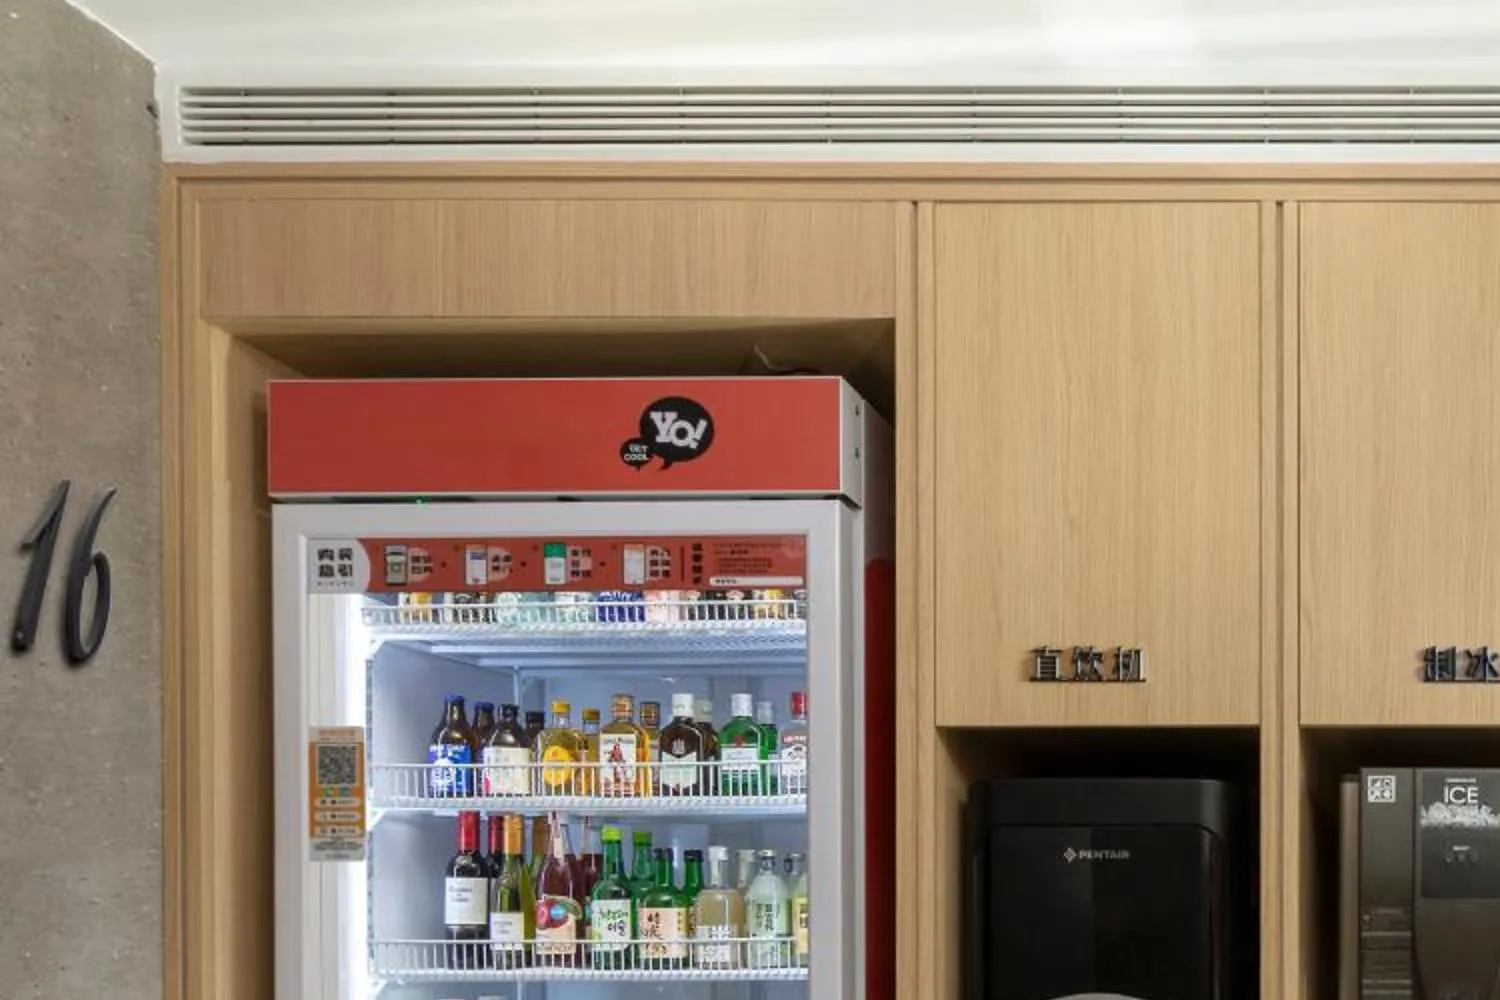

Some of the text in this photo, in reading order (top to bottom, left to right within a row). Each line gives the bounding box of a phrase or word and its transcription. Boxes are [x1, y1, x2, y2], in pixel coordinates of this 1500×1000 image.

[650, 411, 707, 449] YO!
[11, 479, 117, 665] 16
[1029, 645, 1146, 682] 直饮机
[1443, 786, 1479, 804] ICE
[1079, 849, 1130, 860] PENTAIR
